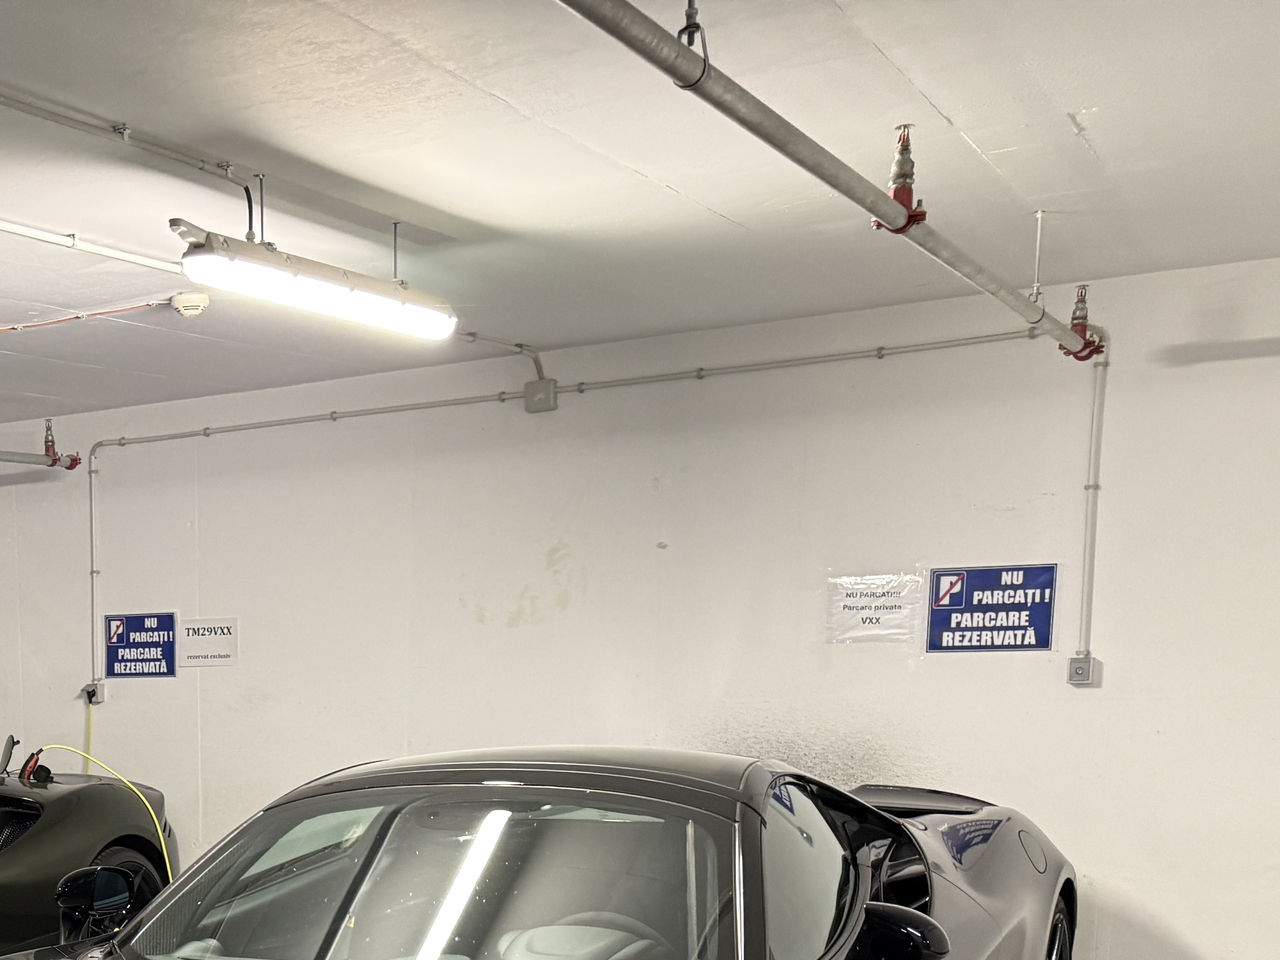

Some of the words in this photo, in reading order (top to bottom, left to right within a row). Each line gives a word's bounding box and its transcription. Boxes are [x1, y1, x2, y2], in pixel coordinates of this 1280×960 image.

[1001, 571, 1024, 585] NU
[845, 591, 858, 599] NU
[144, 617, 158, 629] NU
[861, 616, 881, 625] VXX
[950, 611, 1030, 628] PARCARE
[185, 626, 233, 637] TM29VXX
[941, 627, 1037, 647] REZERVATĂ
[117, 647, 163, 660] PARCARE
[114, 660, 168, 674] REZERVATĂ
